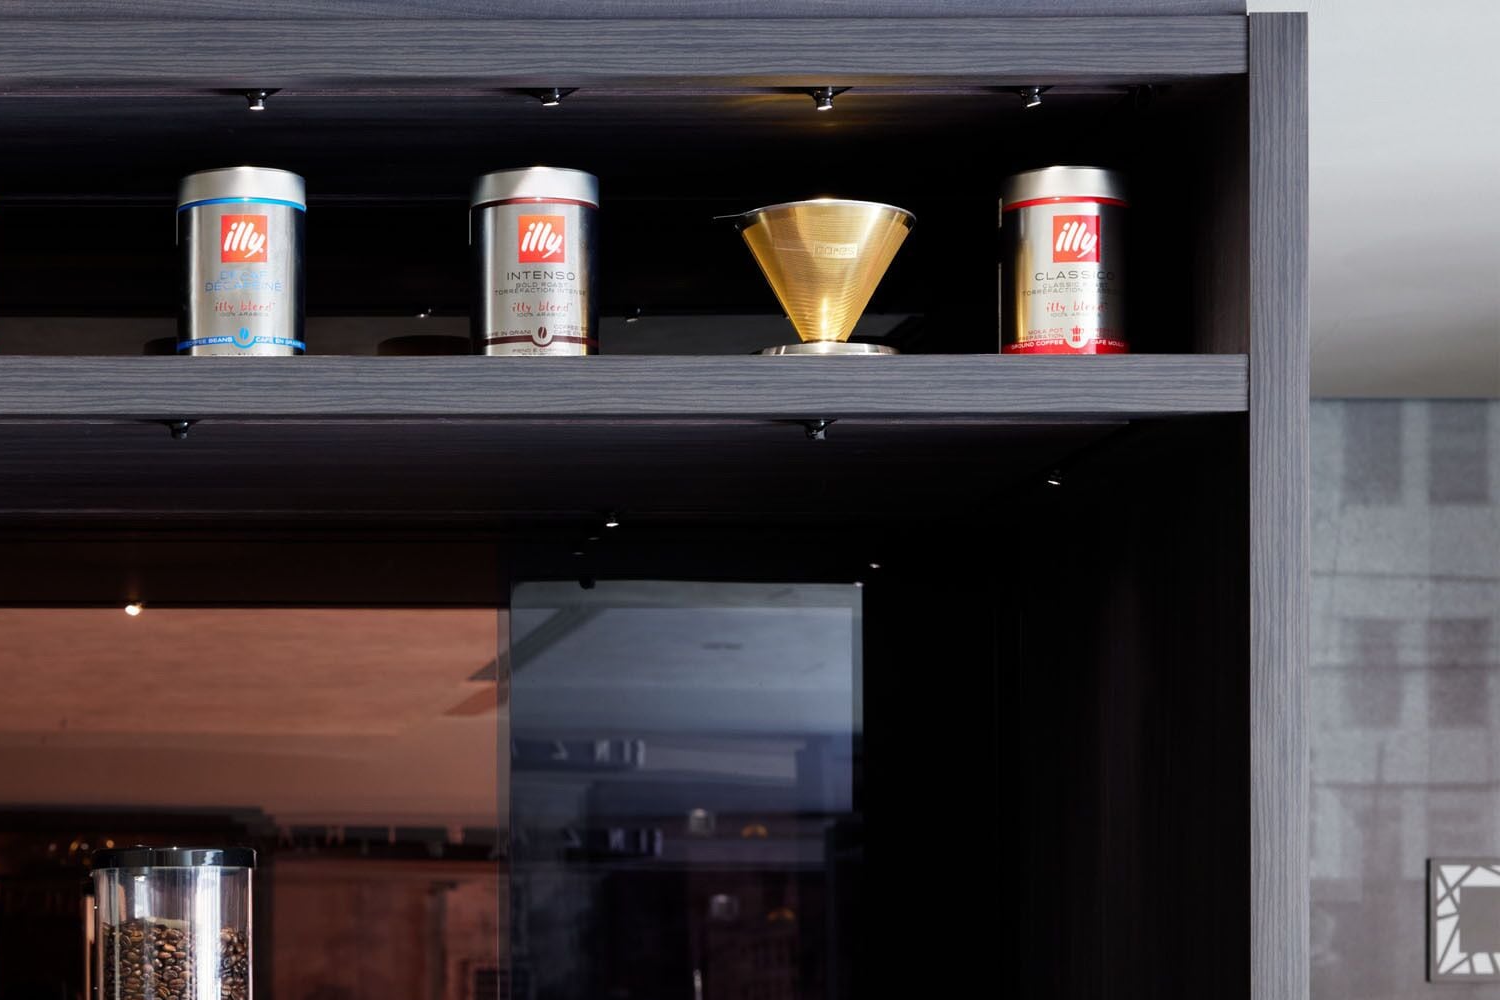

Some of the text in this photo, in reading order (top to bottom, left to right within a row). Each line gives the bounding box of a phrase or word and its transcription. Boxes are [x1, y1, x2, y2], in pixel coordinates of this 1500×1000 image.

[223, 221, 266, 258] illy
[521, 221, 563, 259] illy
[1055, 220, 1098, 259] illy
[506, 270, 576, 281] INTENSO
[1035, 270, 1116, 281] CLASSICO
